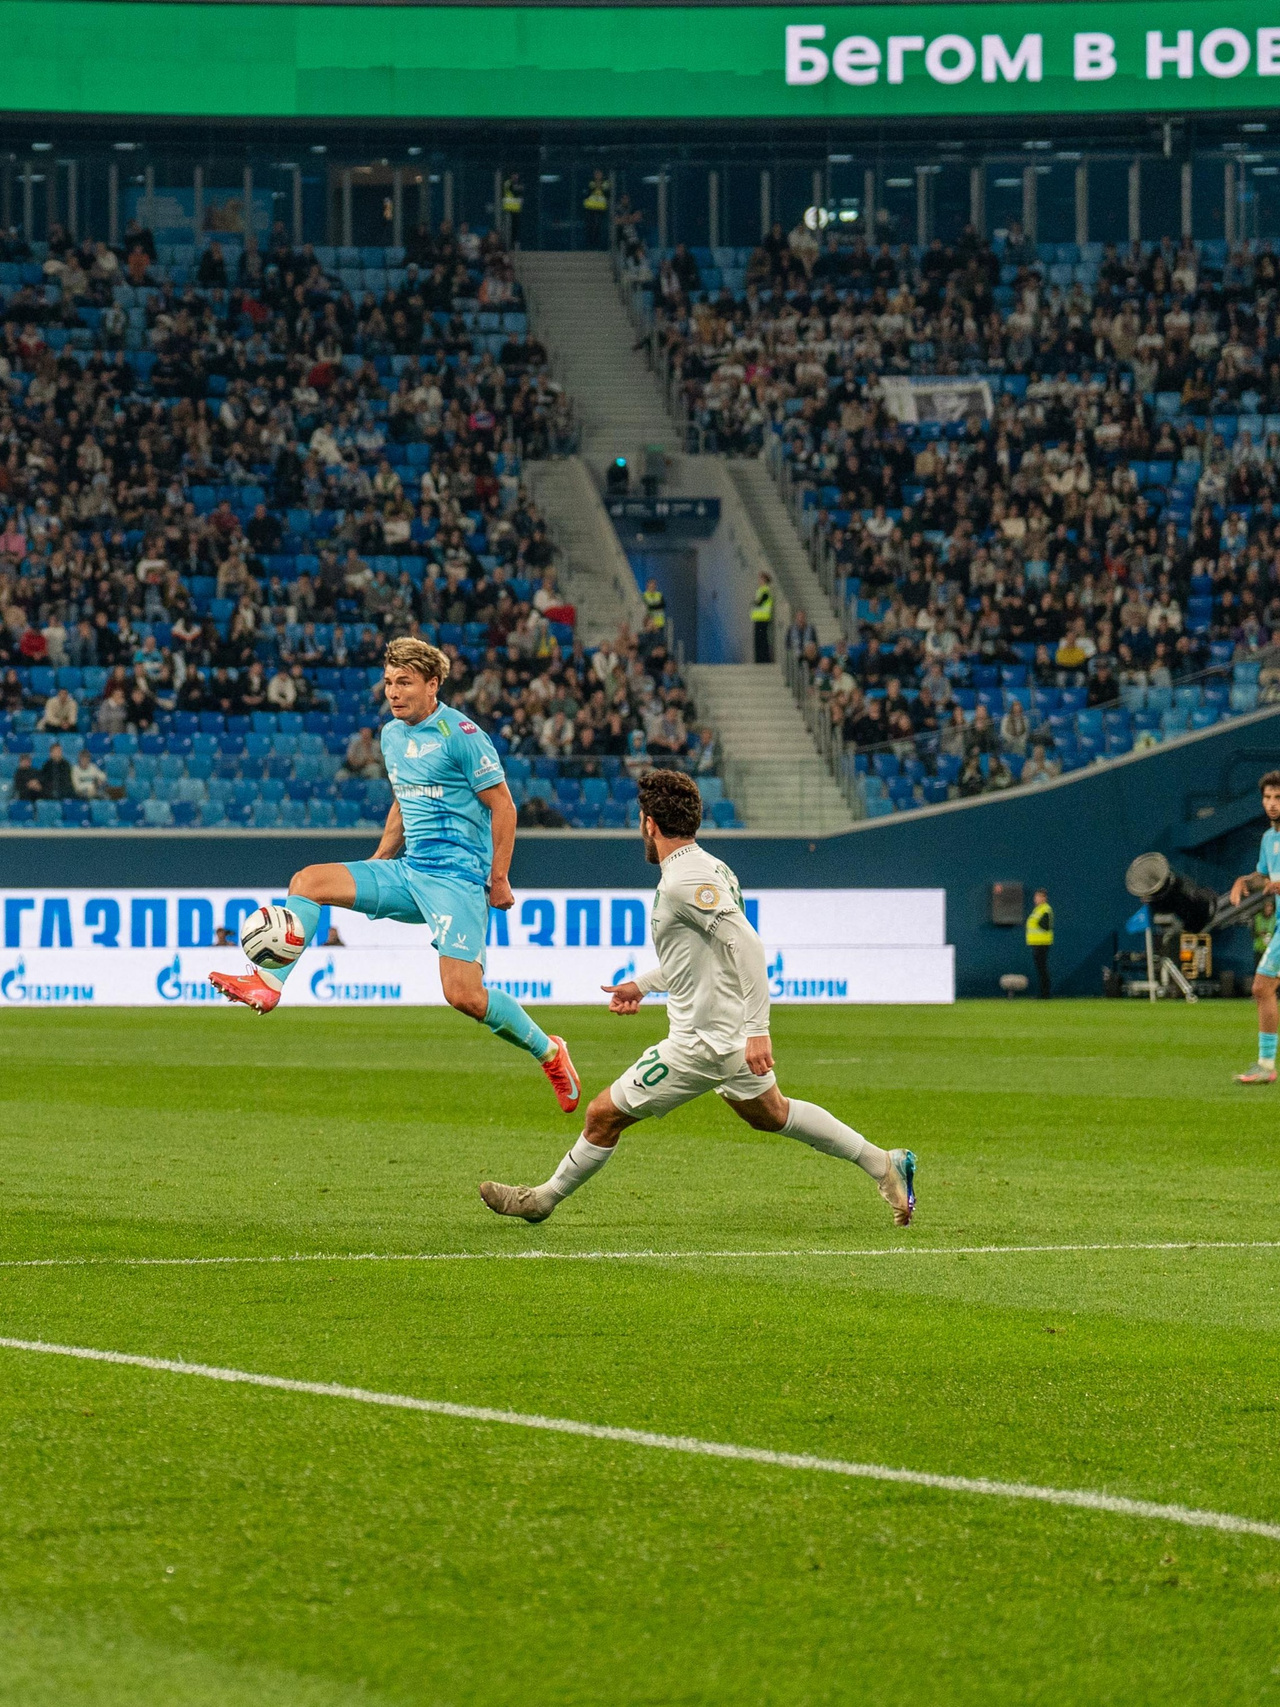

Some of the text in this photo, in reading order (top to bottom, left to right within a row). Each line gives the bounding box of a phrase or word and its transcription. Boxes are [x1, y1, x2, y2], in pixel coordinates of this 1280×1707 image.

[785, 24, 1042, 86] Бегом
[1073, 32, 1117, 81] в
[636, 1049, 669, 1087] 70
